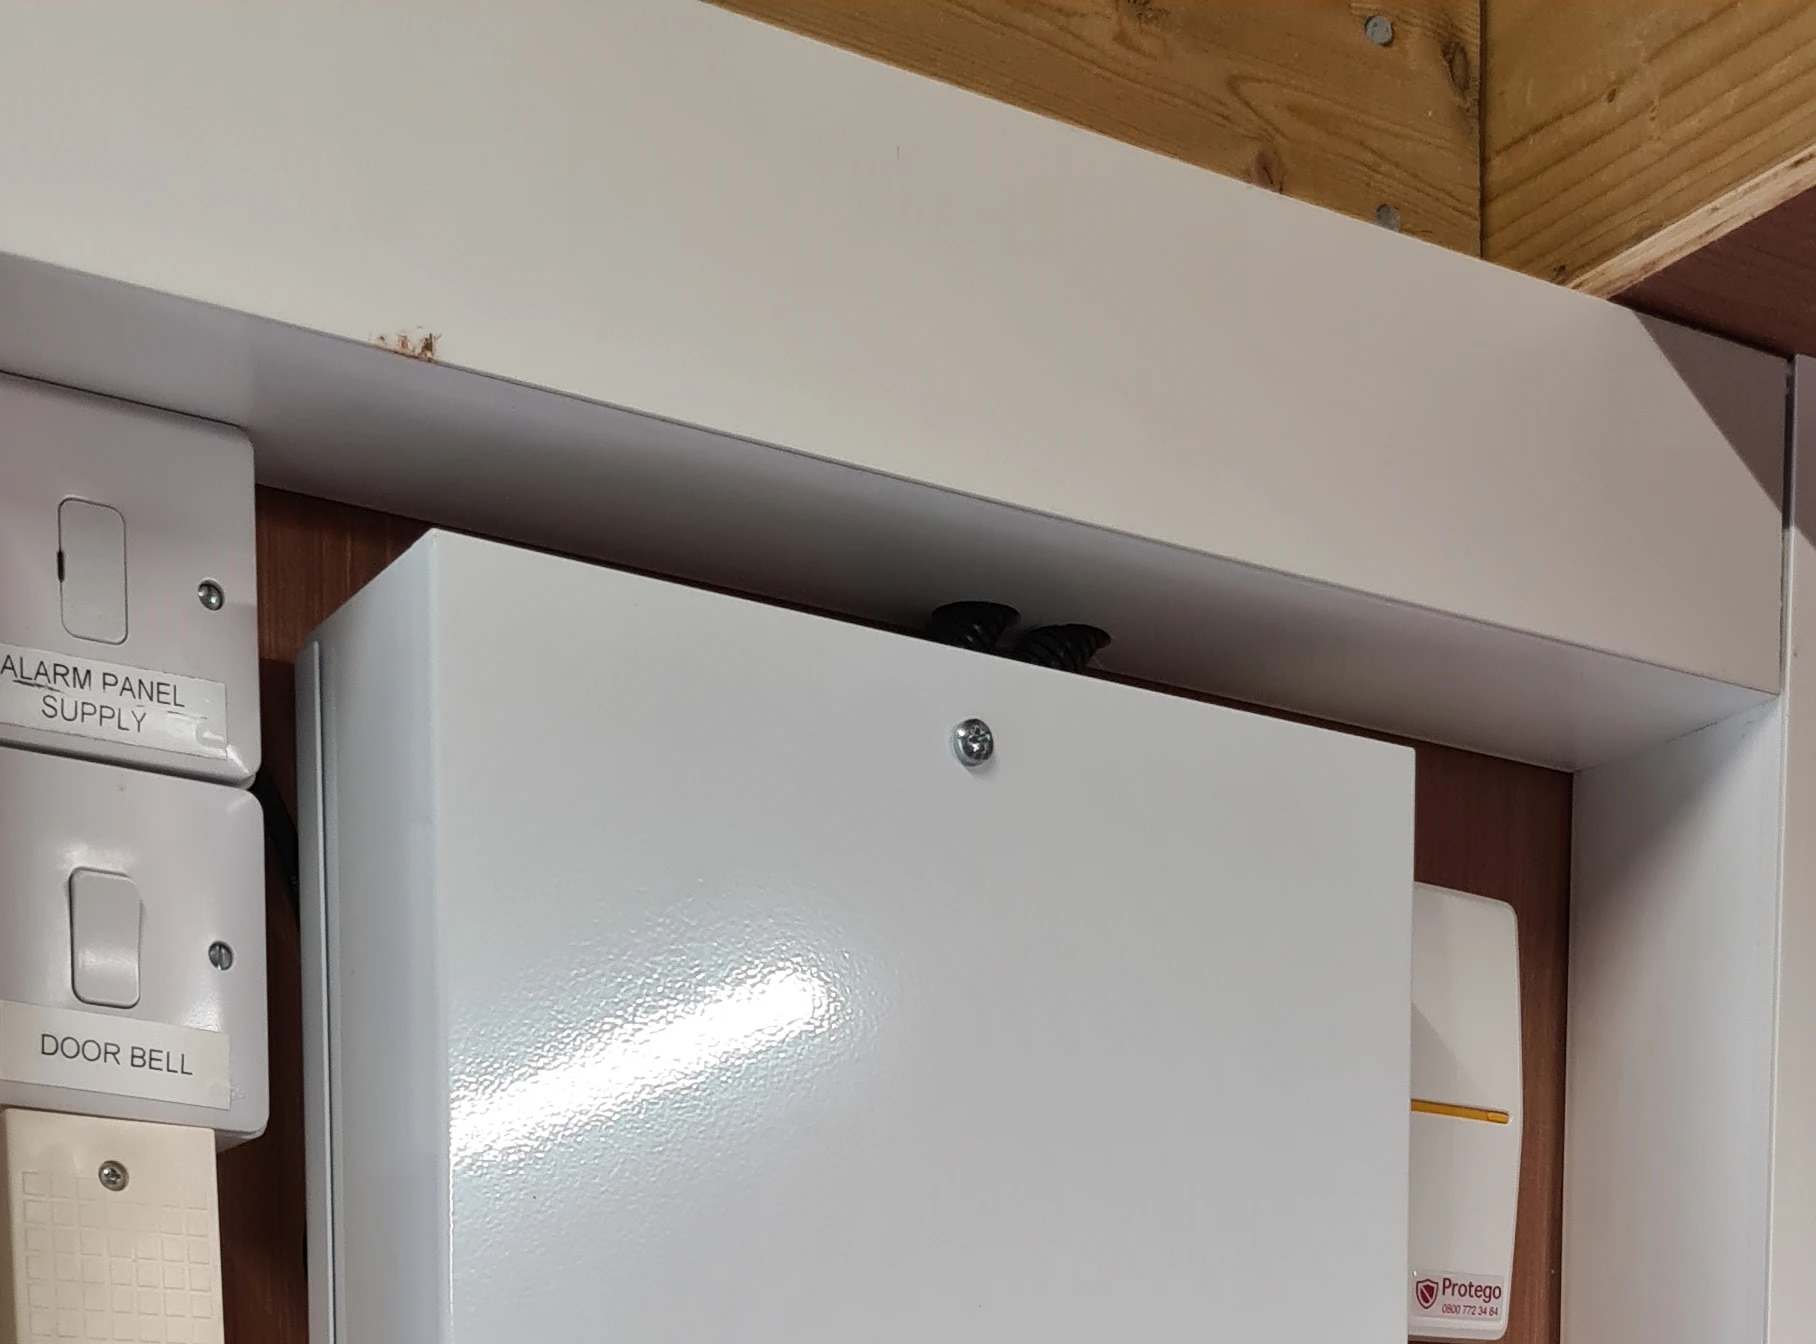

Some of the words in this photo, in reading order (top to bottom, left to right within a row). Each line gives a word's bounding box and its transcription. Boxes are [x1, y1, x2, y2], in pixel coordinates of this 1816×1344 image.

[0, 654, 92, 690] ALARM
[102, 671, 186, 708] PANEL
[41, 694, 148, 733] SUPPLY
[41, 1033, 121, 1066] DOOR
[130, 1046, 193, 1076] BELL
[1441, 1303, 1461, 1315] 0800
[1463, 1305, 1476, 1316] 772
[1478, 1306, 1487, 1316] 34
[1489, 1306, 1499, 1317] 84
[1442, 1278, 1502, 1303] Protego
